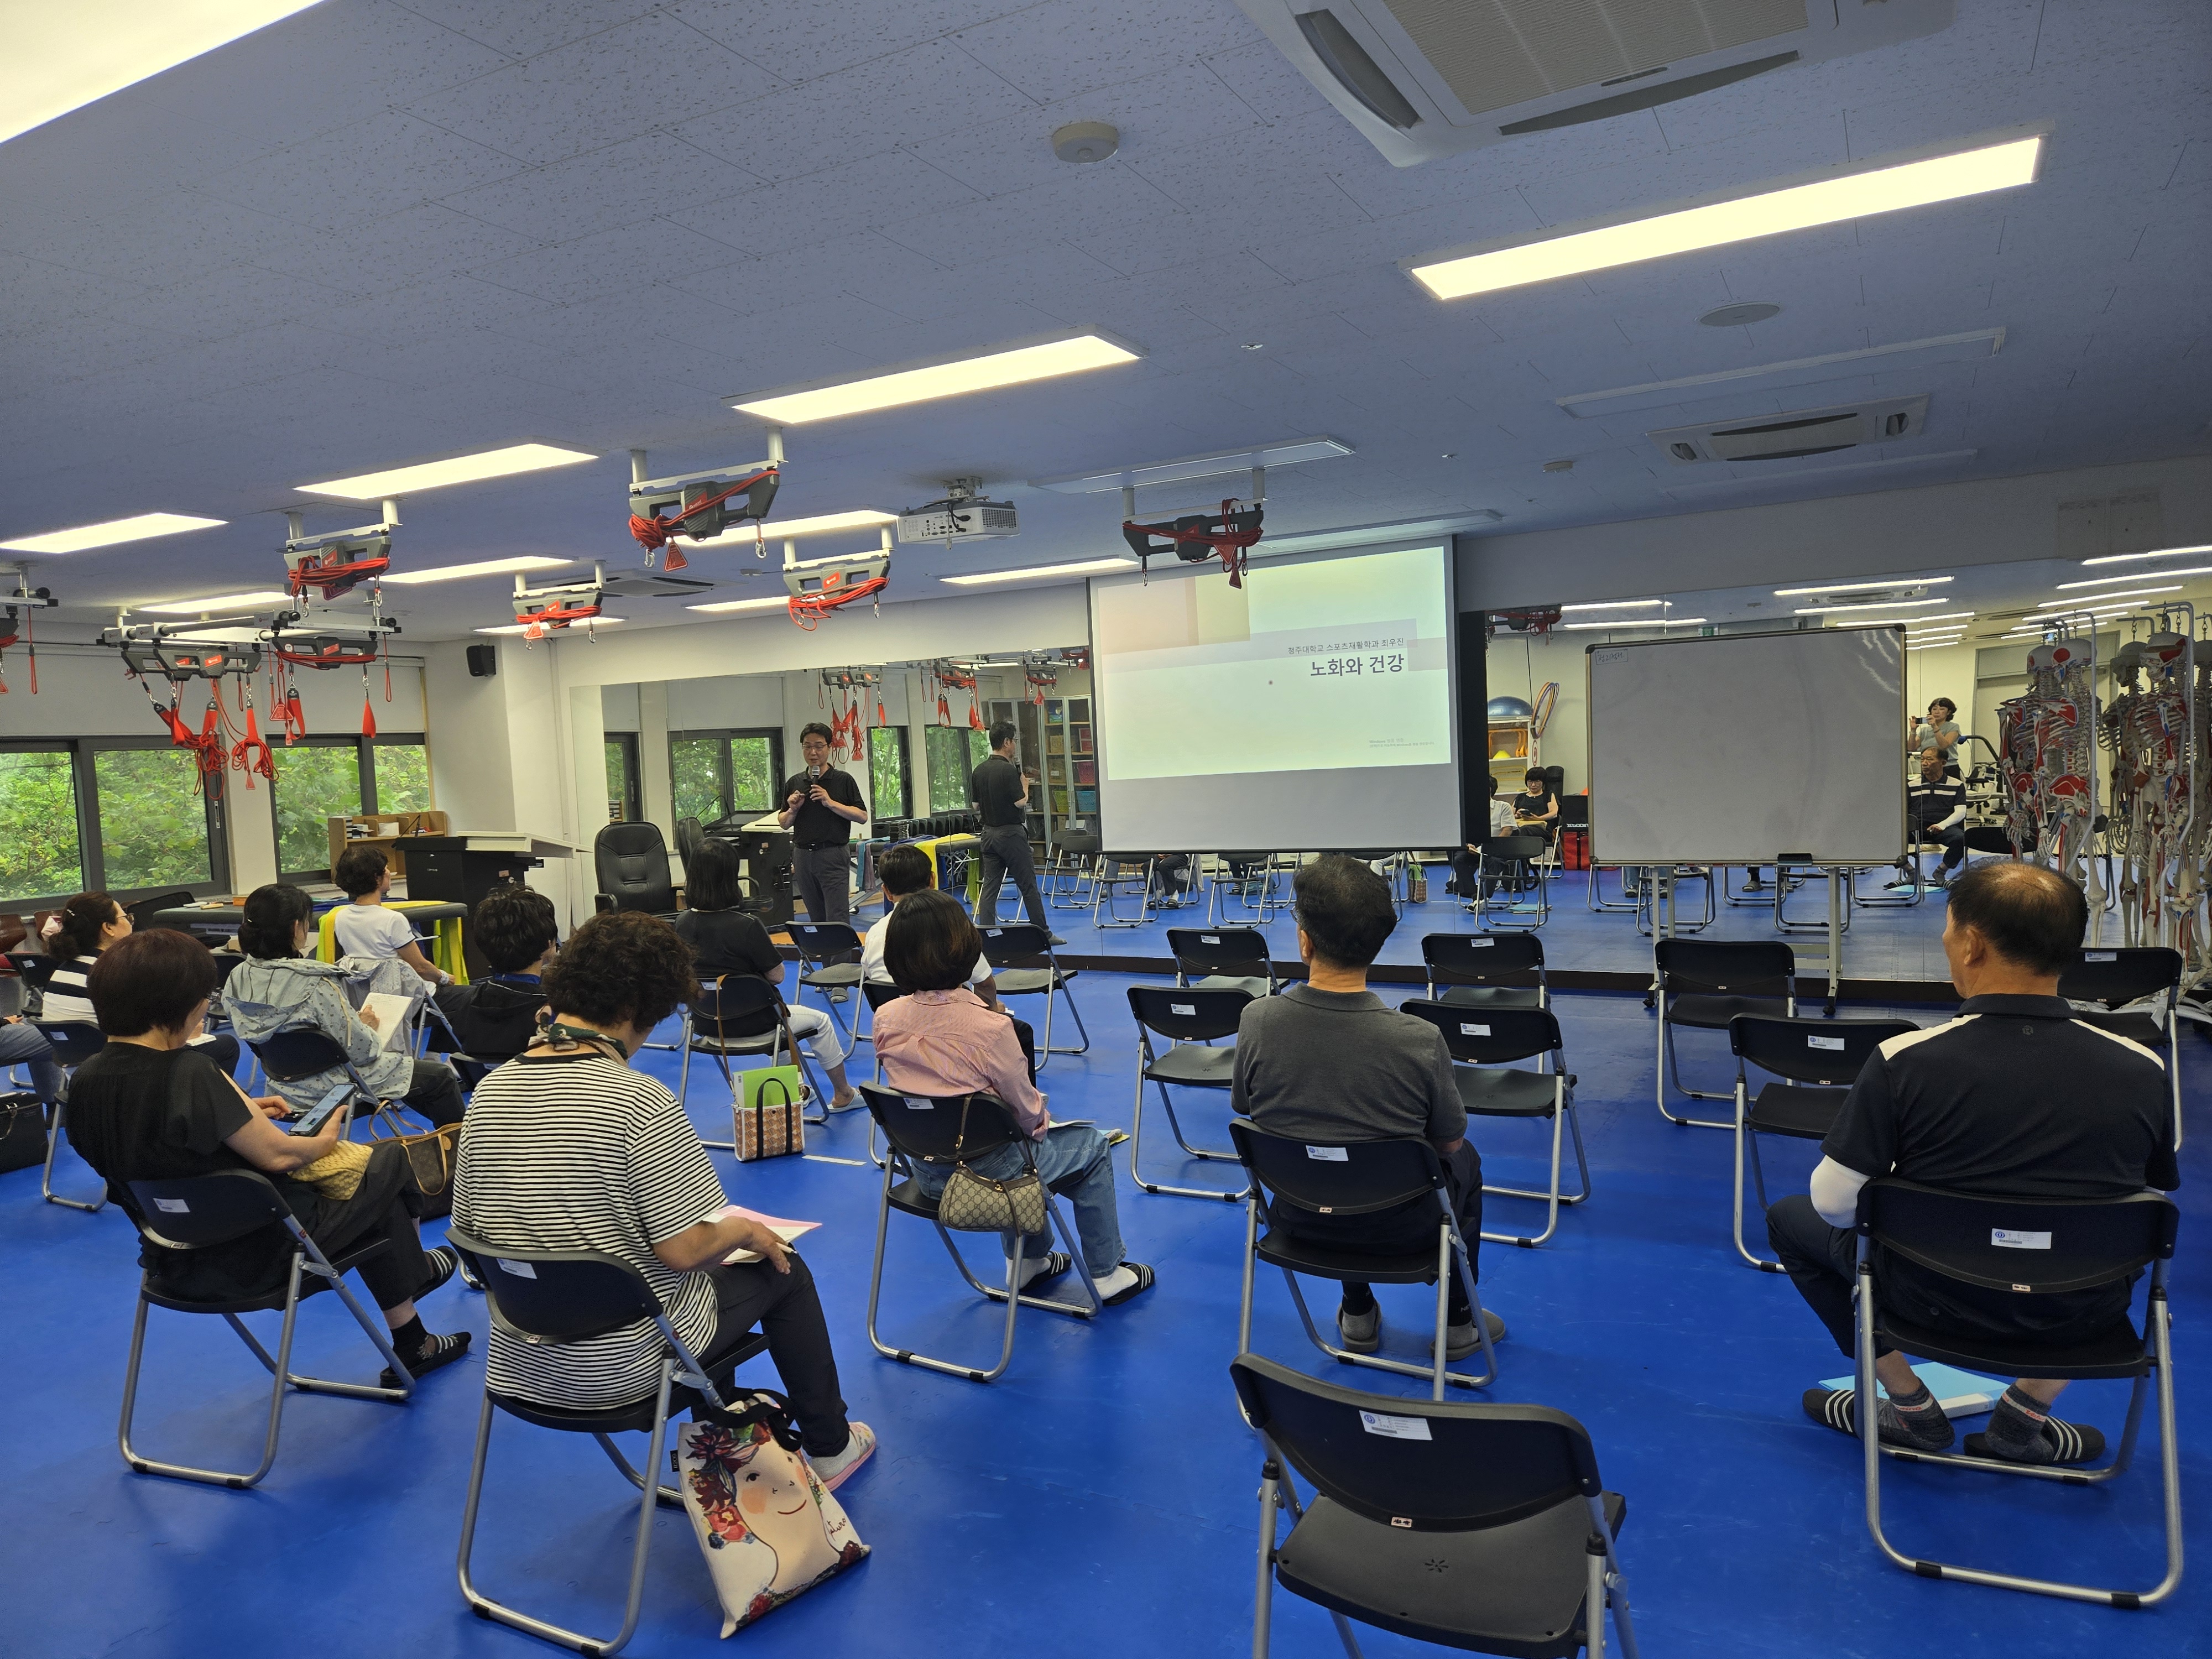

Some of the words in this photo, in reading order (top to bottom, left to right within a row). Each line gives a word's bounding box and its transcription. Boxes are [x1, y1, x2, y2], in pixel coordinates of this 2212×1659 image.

[1288, 644, 1324, 654] 청주대학교
[1326, 640, 1379, 651] 스포츠재활학과
[1381, 638, 1404, 647] 최우진
[1310, 656, 1363, 676] 노화와
[1369, 654, 1404, 674] 건강
